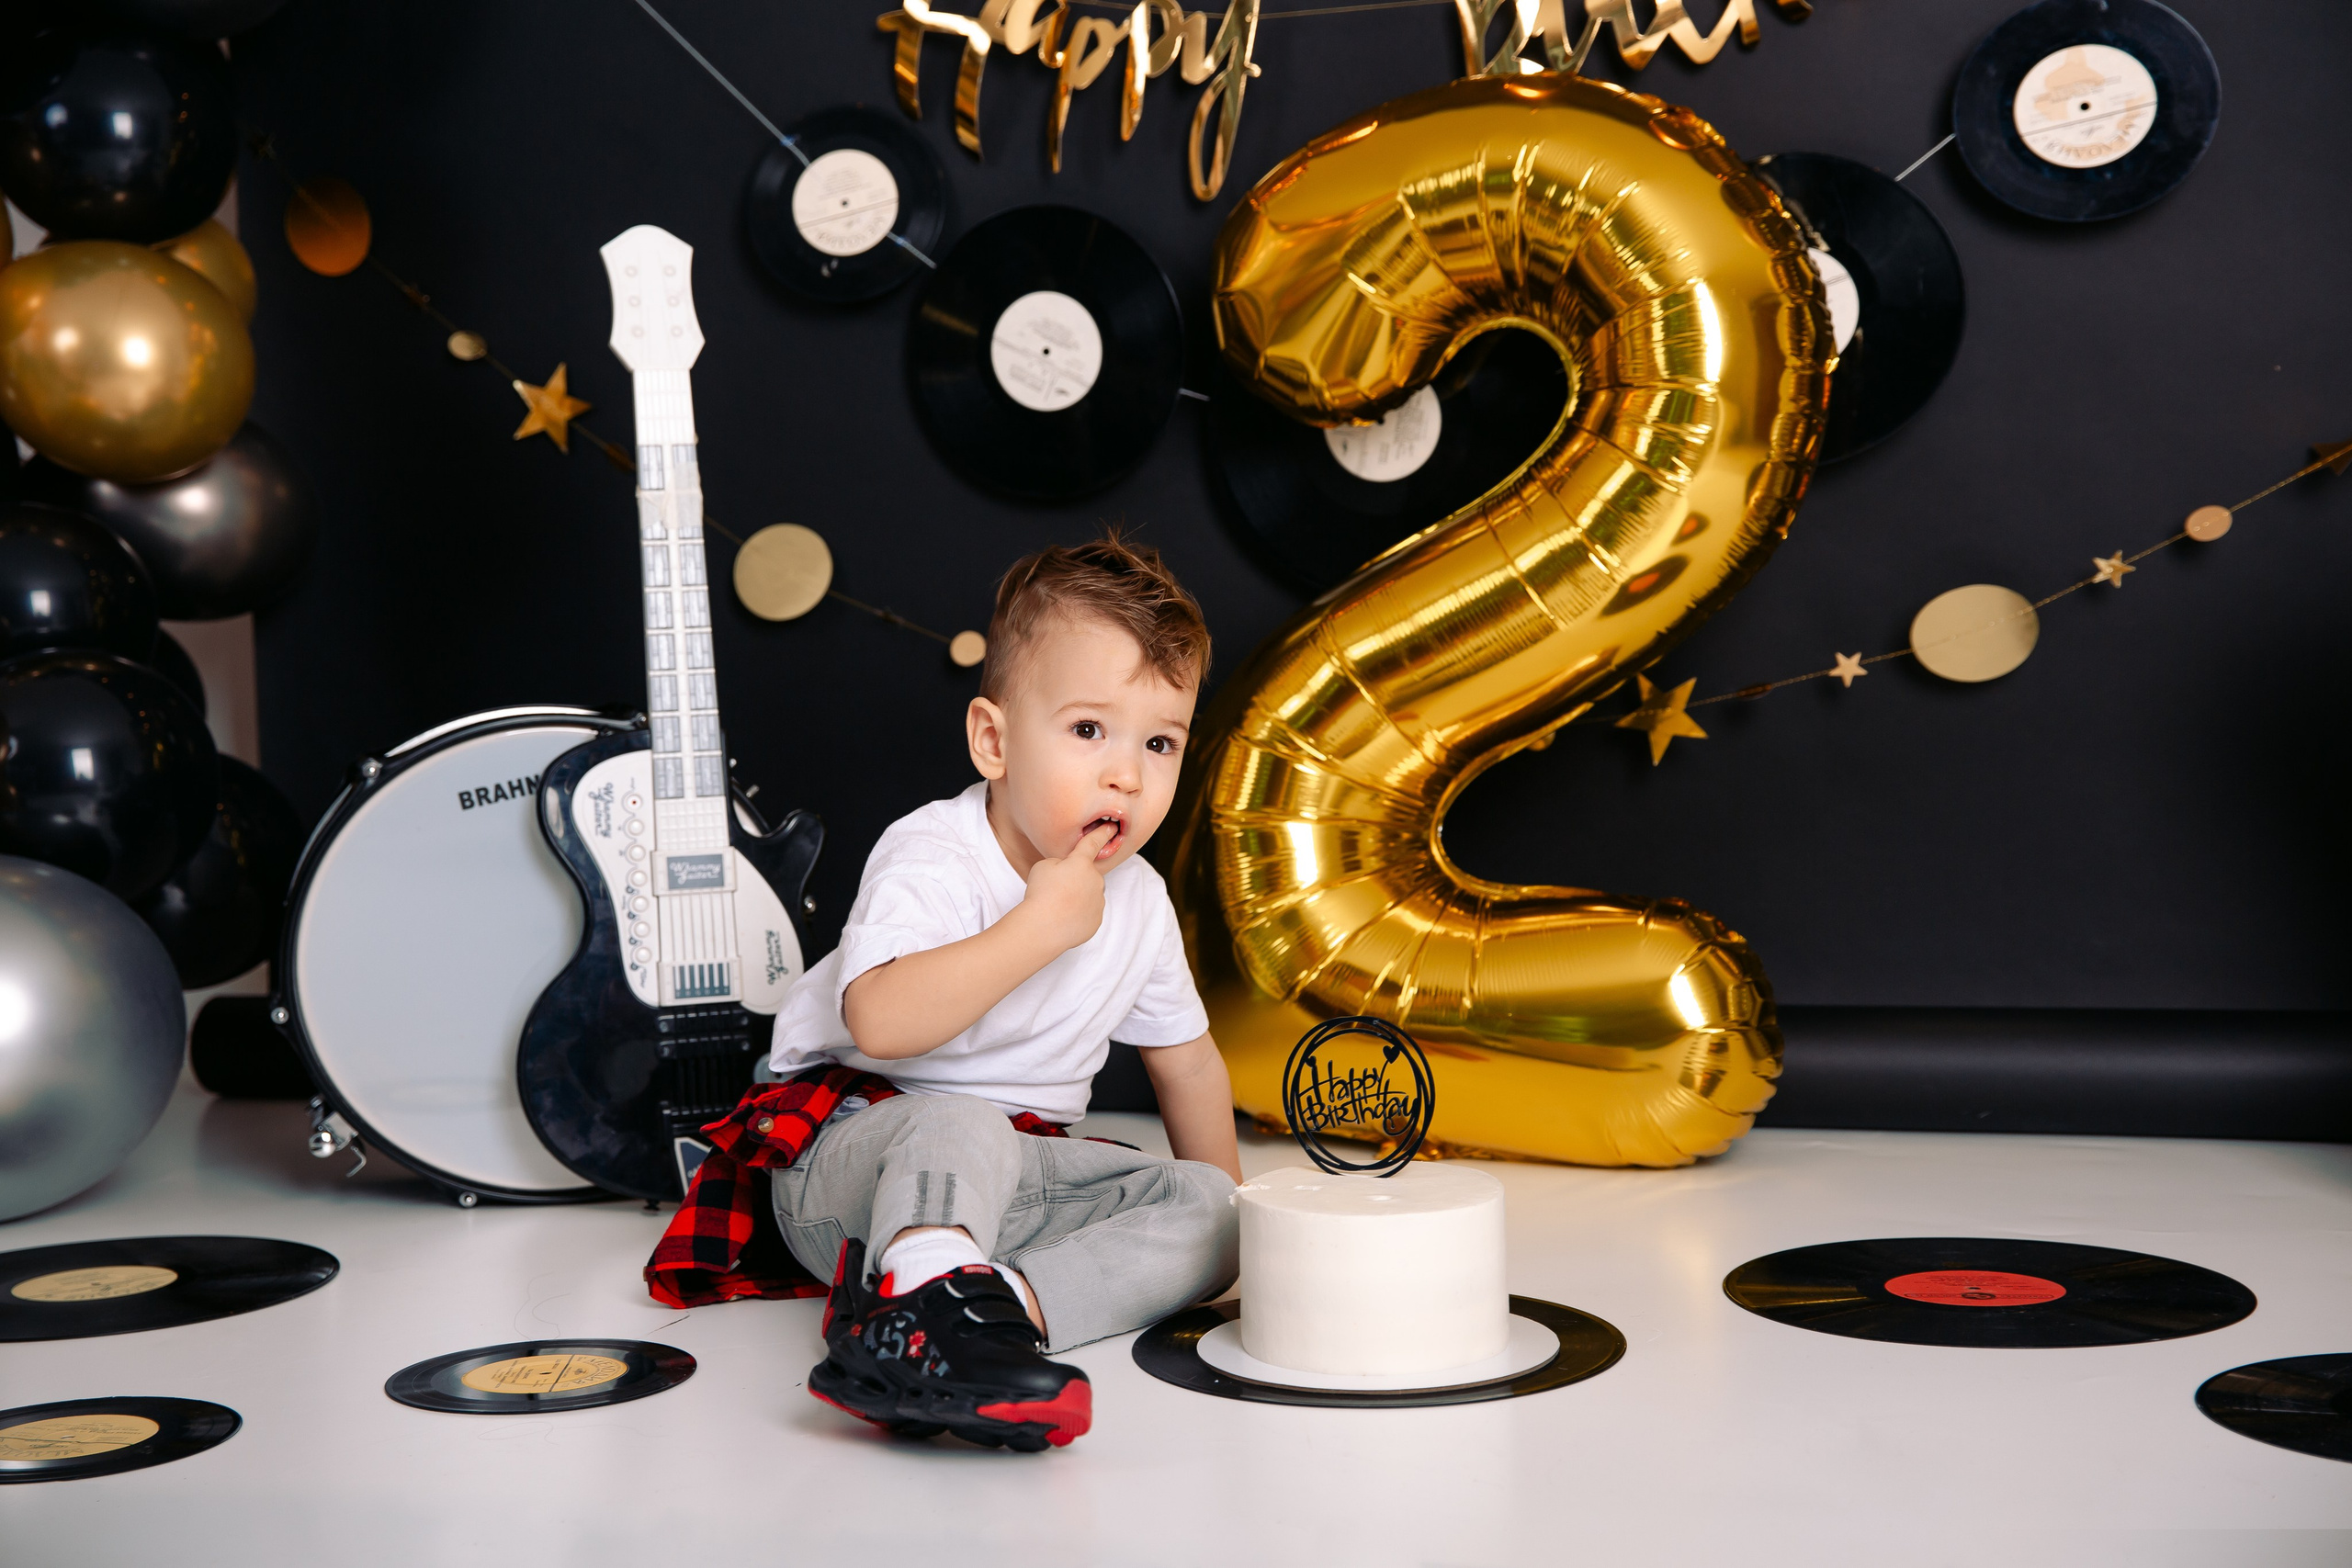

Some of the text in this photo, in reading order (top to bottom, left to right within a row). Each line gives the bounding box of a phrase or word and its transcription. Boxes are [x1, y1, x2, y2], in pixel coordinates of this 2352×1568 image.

[876, 0, 1262, 201] Happy
[1211, 72, 1839, 1169] 2
[1298, 1058, 1390, 1105] Happy
